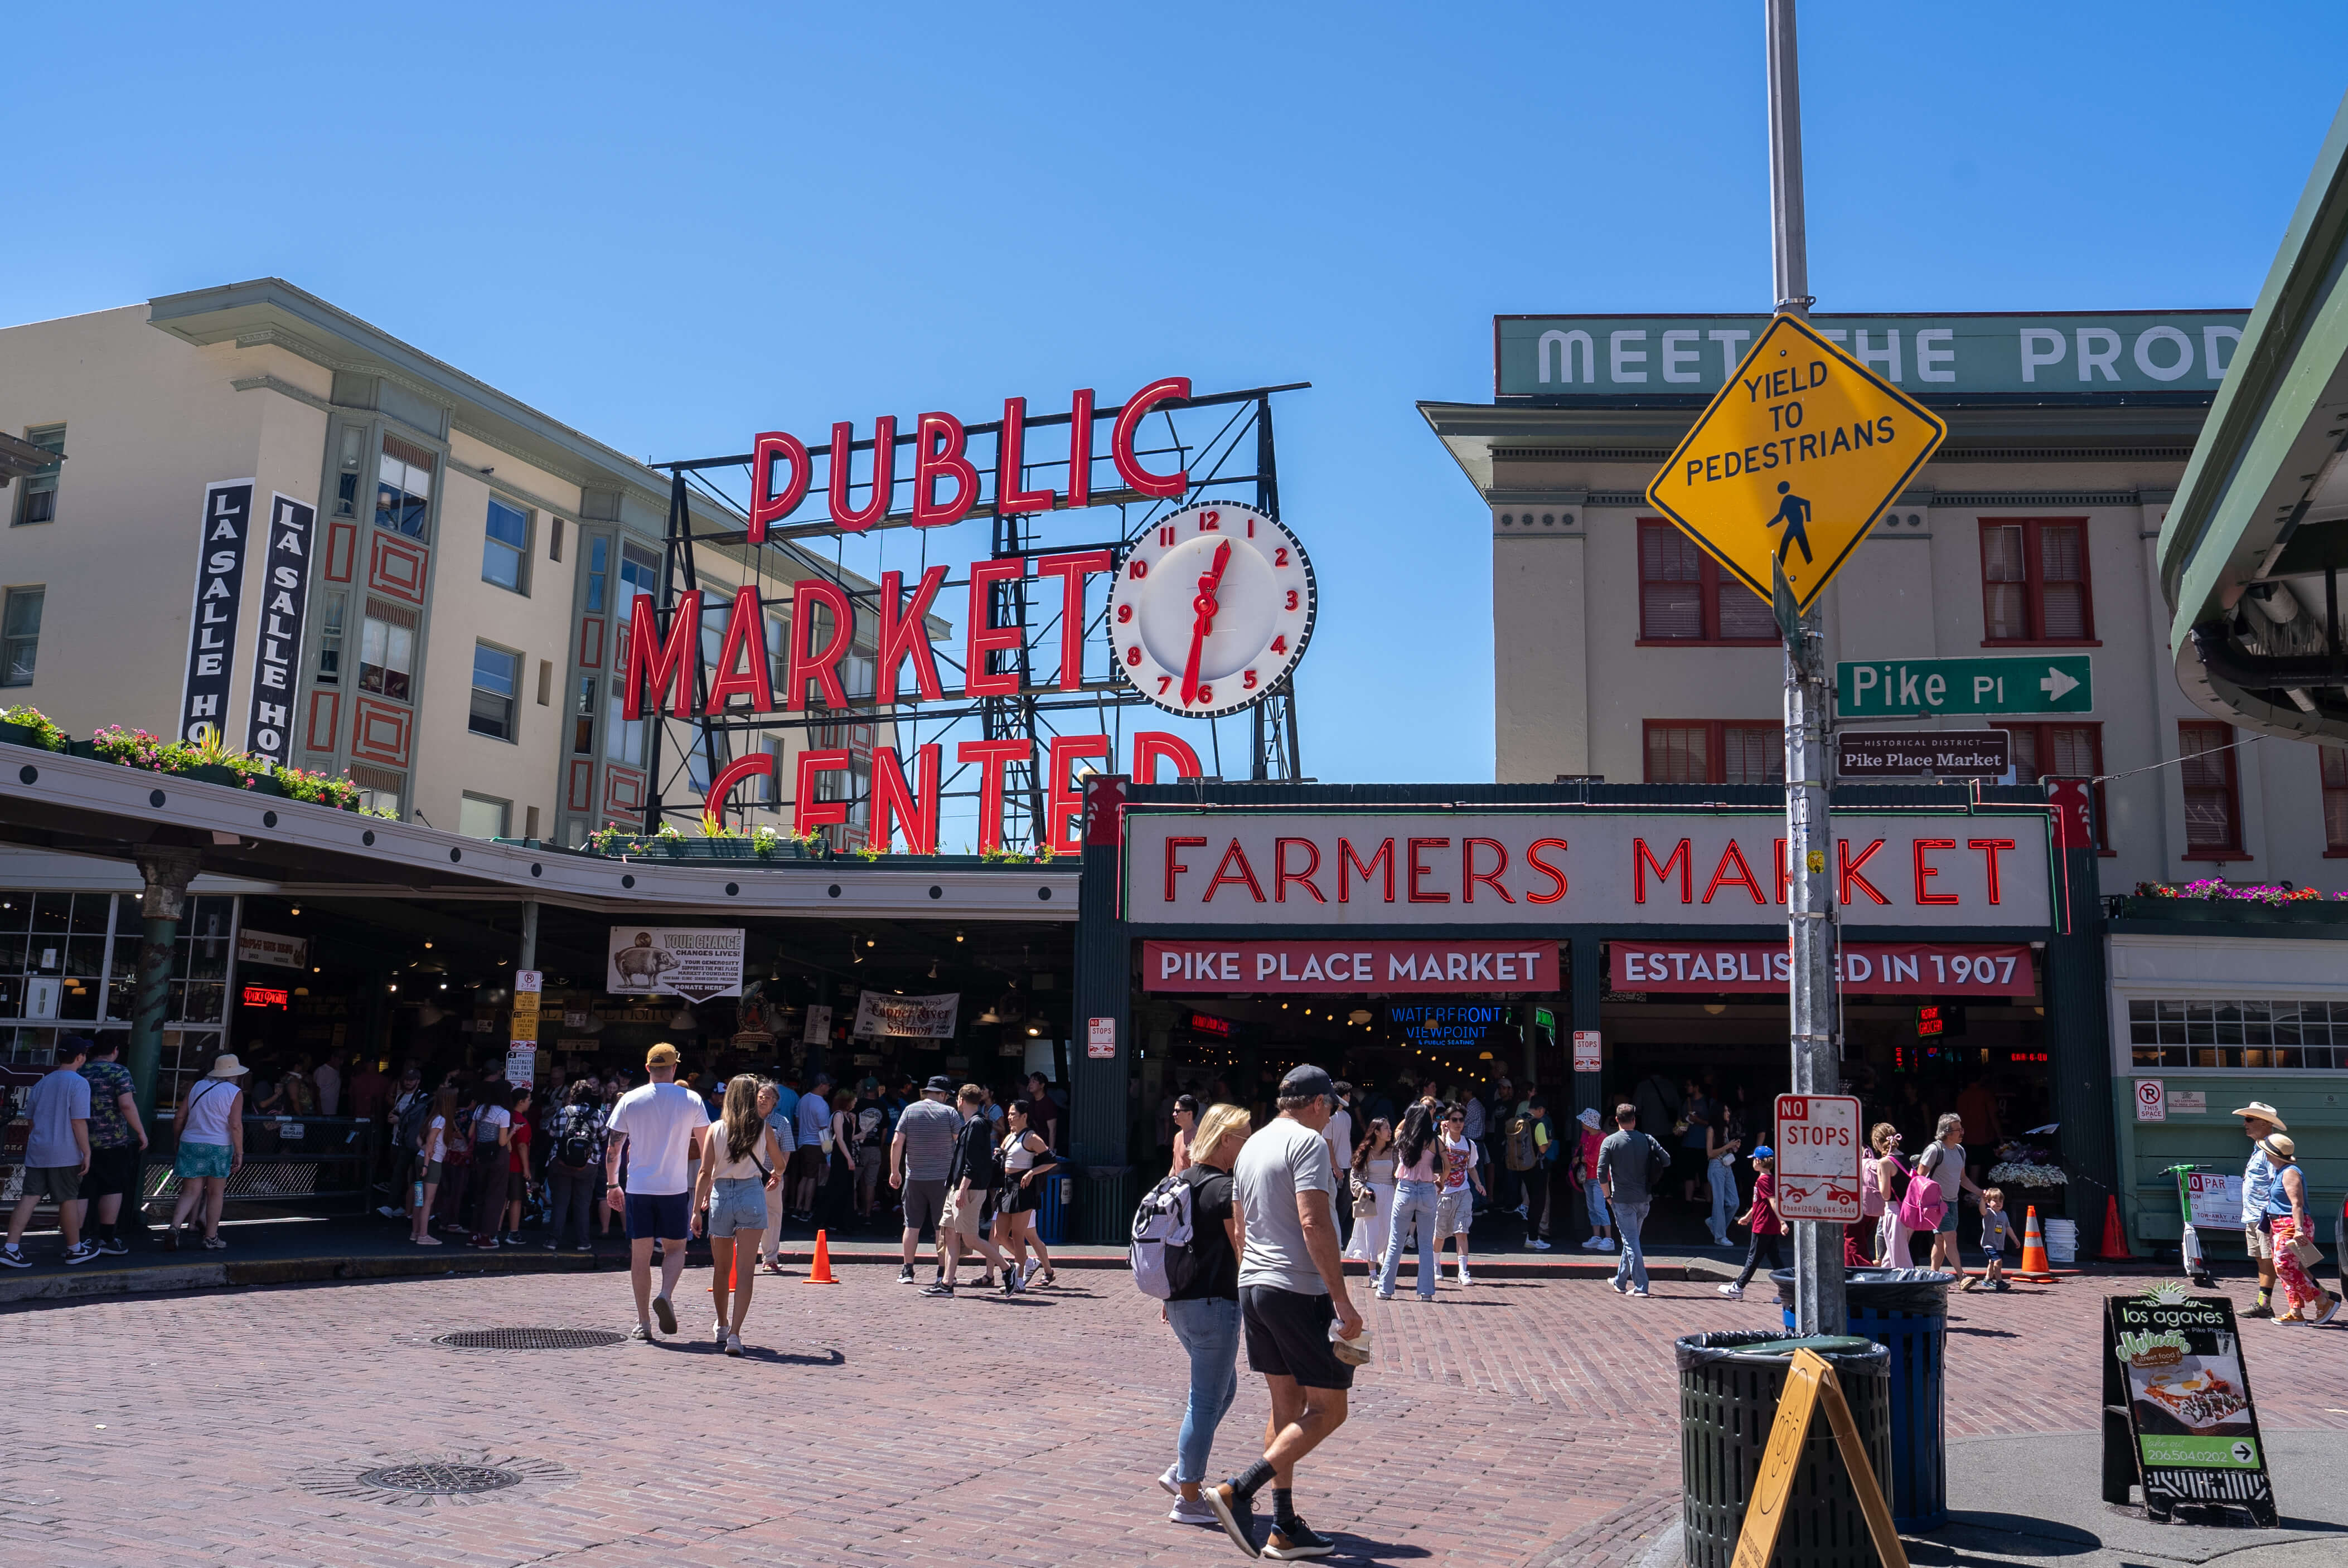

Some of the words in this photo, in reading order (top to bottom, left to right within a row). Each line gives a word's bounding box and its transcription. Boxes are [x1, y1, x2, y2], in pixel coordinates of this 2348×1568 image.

[1538, 329, 1750, 385] MEET
[1743, 361, 1827, 402] YIELD
[1769, 401, 1803, 432] TO
[748, 377, 1192, 543] PUBLIC
[1687, 416, 1895, 486] PEDESTRIANS
[210, 494, 240, 541] LA
[1199, 511, 1219, 531] 12
[277, 503, 304, 556] LA
[1160, 526, 1175, 547] 11
[1247, 519, 1253, 538] 1
[1275, 547, 1289, 567] 2
[1129, 560, 1148, 580] 10
[1285, 590, 1298, 611] 3
[197, 551, 236, 676] SALLE
[1117, 605, 1132, 624] 9
[263, 567, 298, 690] SALLE
[622, 550, 1112, 721] MARKET
[1270, 635, 1287, 656] 4
[1127, 647, 1142, 667] 8
[1157, 676, 1172, 696] 7
[1243, 670, 1257, 690] 5
[1853, 665, 1946, 706] Pike
[1974, 676, 2003, 704] Pl
[1198, 685, 1213, 704] 6
[255, 701, 286, 775] HOT
[1844, 754, 1882, 766] Pike
[1886, 754, 1933, 766] Place
[1937, 753, 2001, 766] Market
[1164, 837, 1568, 904] FARMERS
[664, 934, 695, 949] YOUR
[696, 935, 741, 949] CHANGE
[1160, 952, 1240, 980] PIKE
[1257, 952, 1374, 981] PLACE
[1388, 952, 1540, 982] MARKET
[1625, 953, 1871, 983] ESTABLISED
[1884, 954, 1918, 983] IN
[1930, 954, 2016, 984] 1907
[872, 1004, 913, 1021] Copper
[1392, 1007, 1502, 1022] WATERFRONT
[885, 1021, 932, 1036] Salmon
[1406, 1026, 1487, 1038] VIEWPOINT
[1782, 1101, 1803, 1116] NO
[1788, 1126, 1849, 1146] STOPS
[2123, 1307, 2148, 1323] los
[2153, 1311, 2224, 1327] agaves
[2115, 1328, 2191, 1362] Mexican
[2138, 1353, 2158, 1362] street
[2145, 1436, 2168, 1447] take
[2170, 1438, 2185, 1448] out
[2147, 1449, 2228, 1462] 206.504.0202
